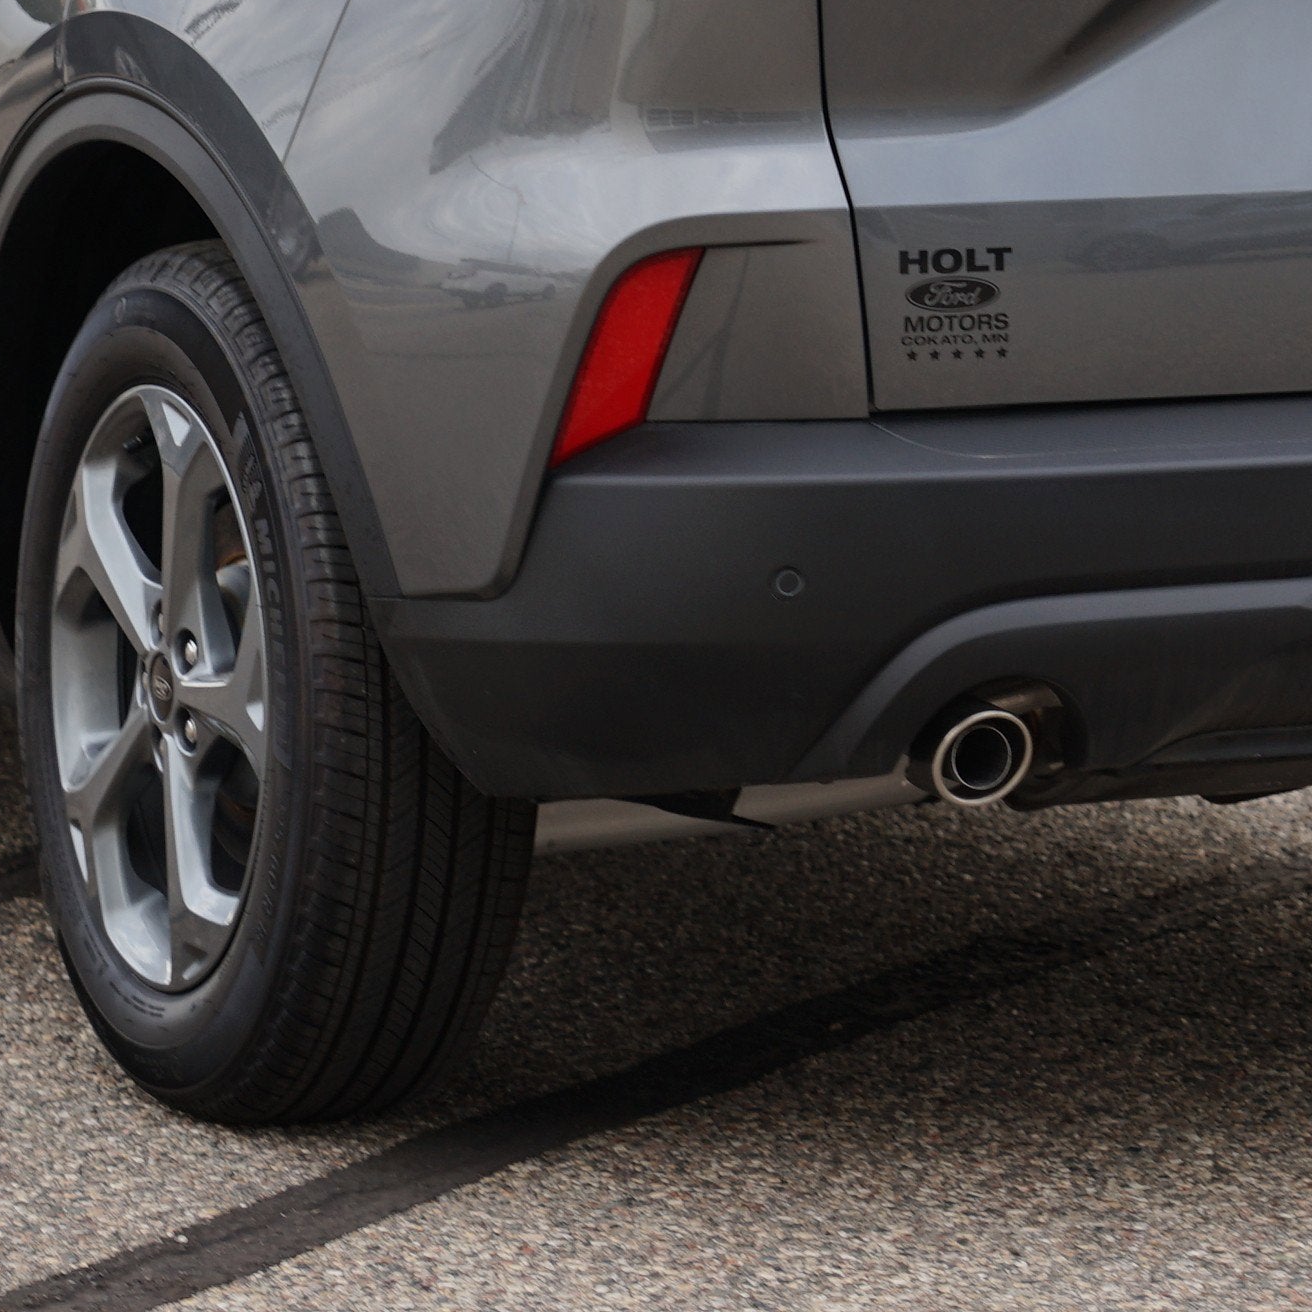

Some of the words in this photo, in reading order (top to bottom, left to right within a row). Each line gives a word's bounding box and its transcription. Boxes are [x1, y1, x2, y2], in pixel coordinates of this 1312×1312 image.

[899, 247, 1012, 274] HOLT
[924, 281, 982, 306] Ford
[904, 313, 1010, 333] MOTORS
